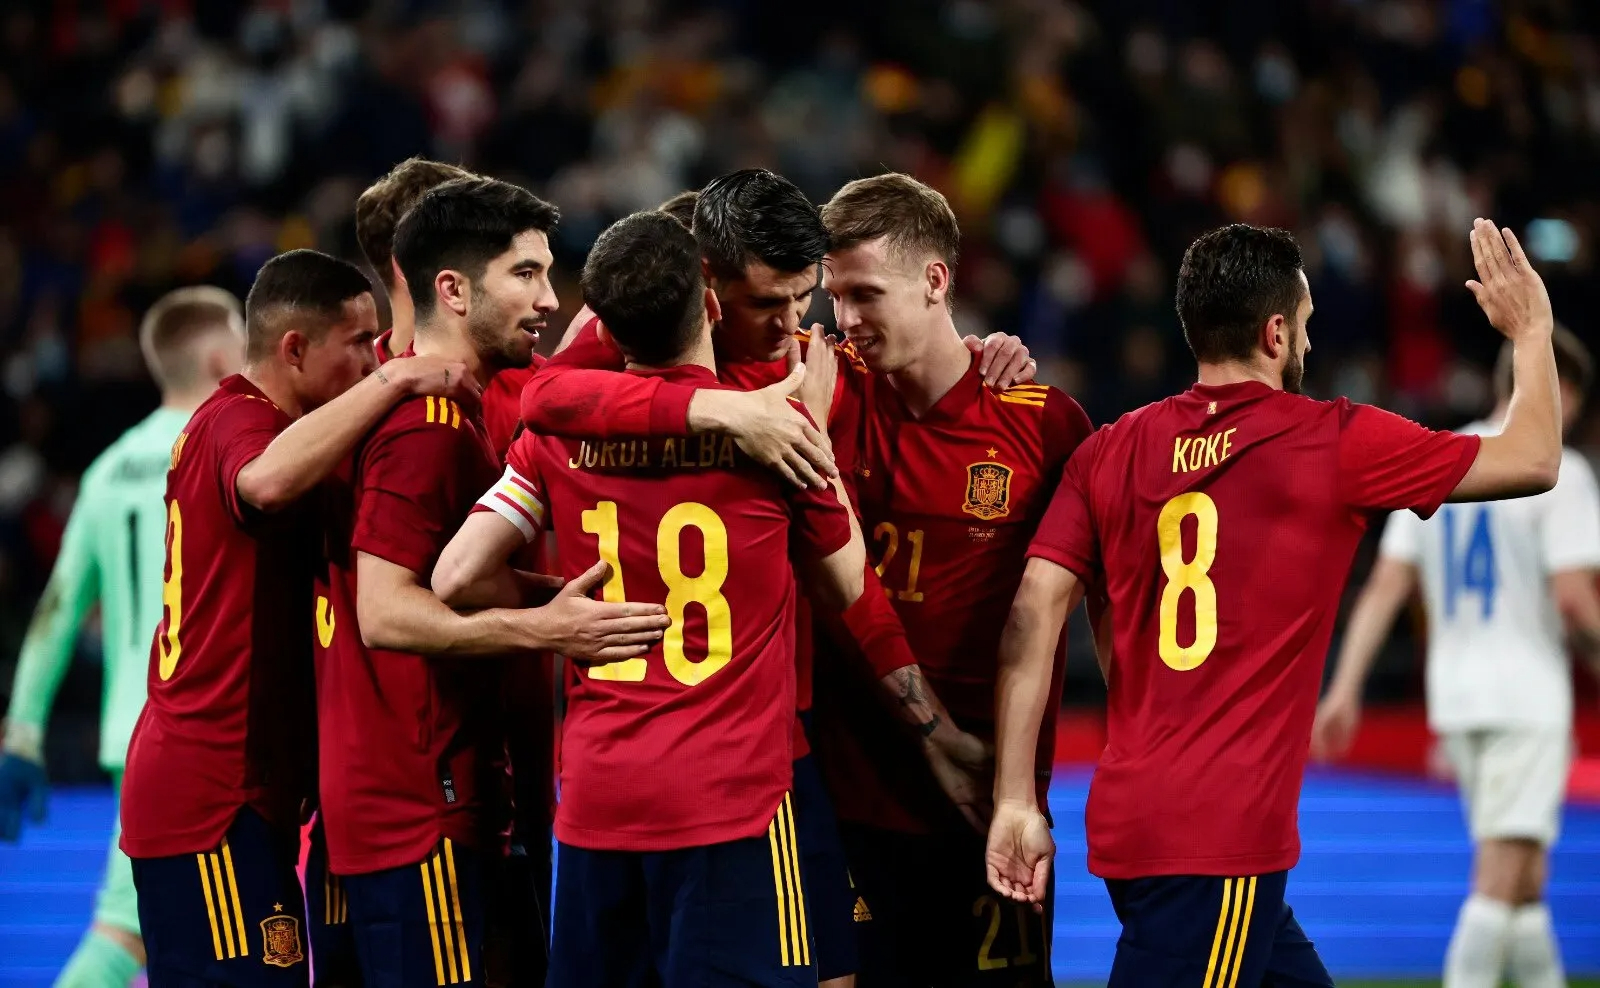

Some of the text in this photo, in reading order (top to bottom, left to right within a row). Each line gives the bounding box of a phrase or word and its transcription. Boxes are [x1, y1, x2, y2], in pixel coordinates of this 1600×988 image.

[661, 432, 735, 468] ALBA
[1172, 427, 1238, 473] KOKE
[581, 500, 733, 687] 18
[873, 521, 925, 603] 21
[1157, 491, 1219, 671] 8
[1441, 502, 1496, 621] 14
[971, 893, 1038, 971] 21
